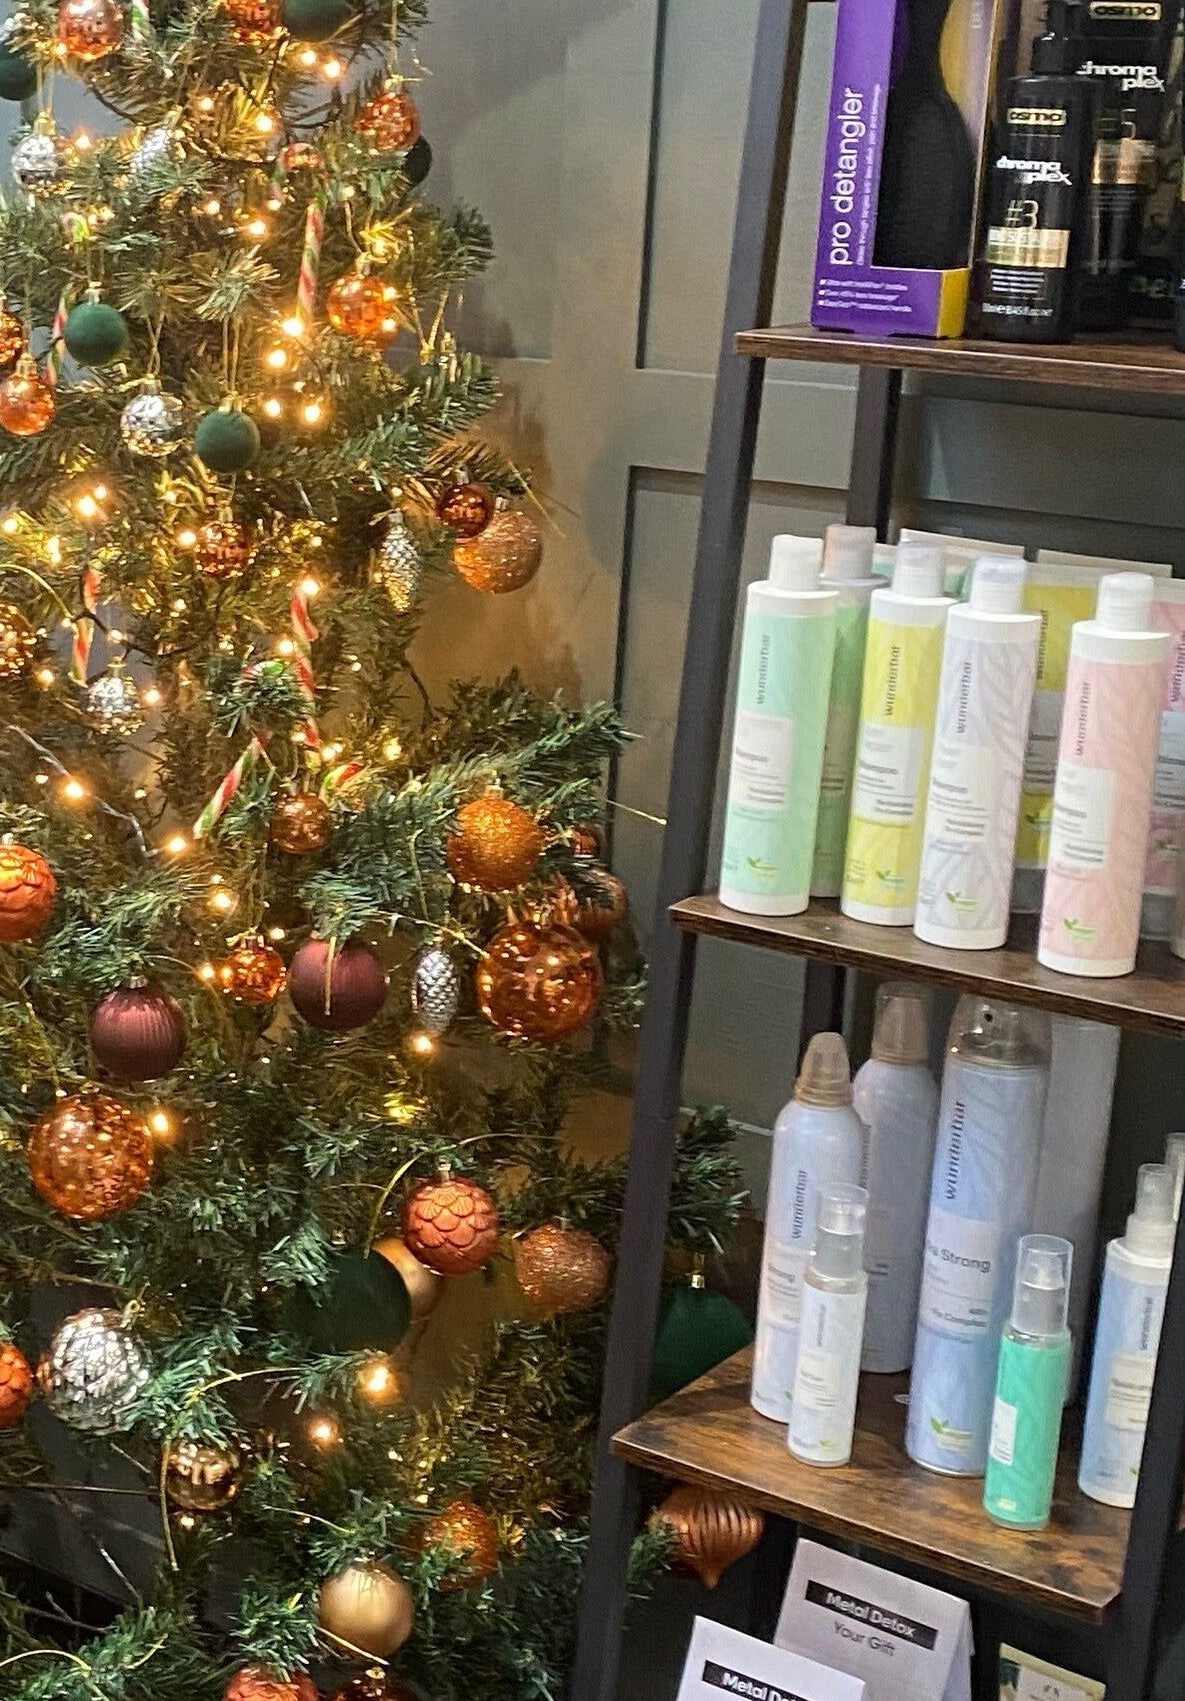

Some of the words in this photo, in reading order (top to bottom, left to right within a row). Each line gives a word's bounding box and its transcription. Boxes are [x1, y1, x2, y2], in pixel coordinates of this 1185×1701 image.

[830, 87, 866, 213] detangler
[830, 221, 853, 265] pro
[940, 1248, 991, 1274] Strong
[722, 1672, 768, 1701] Metal
